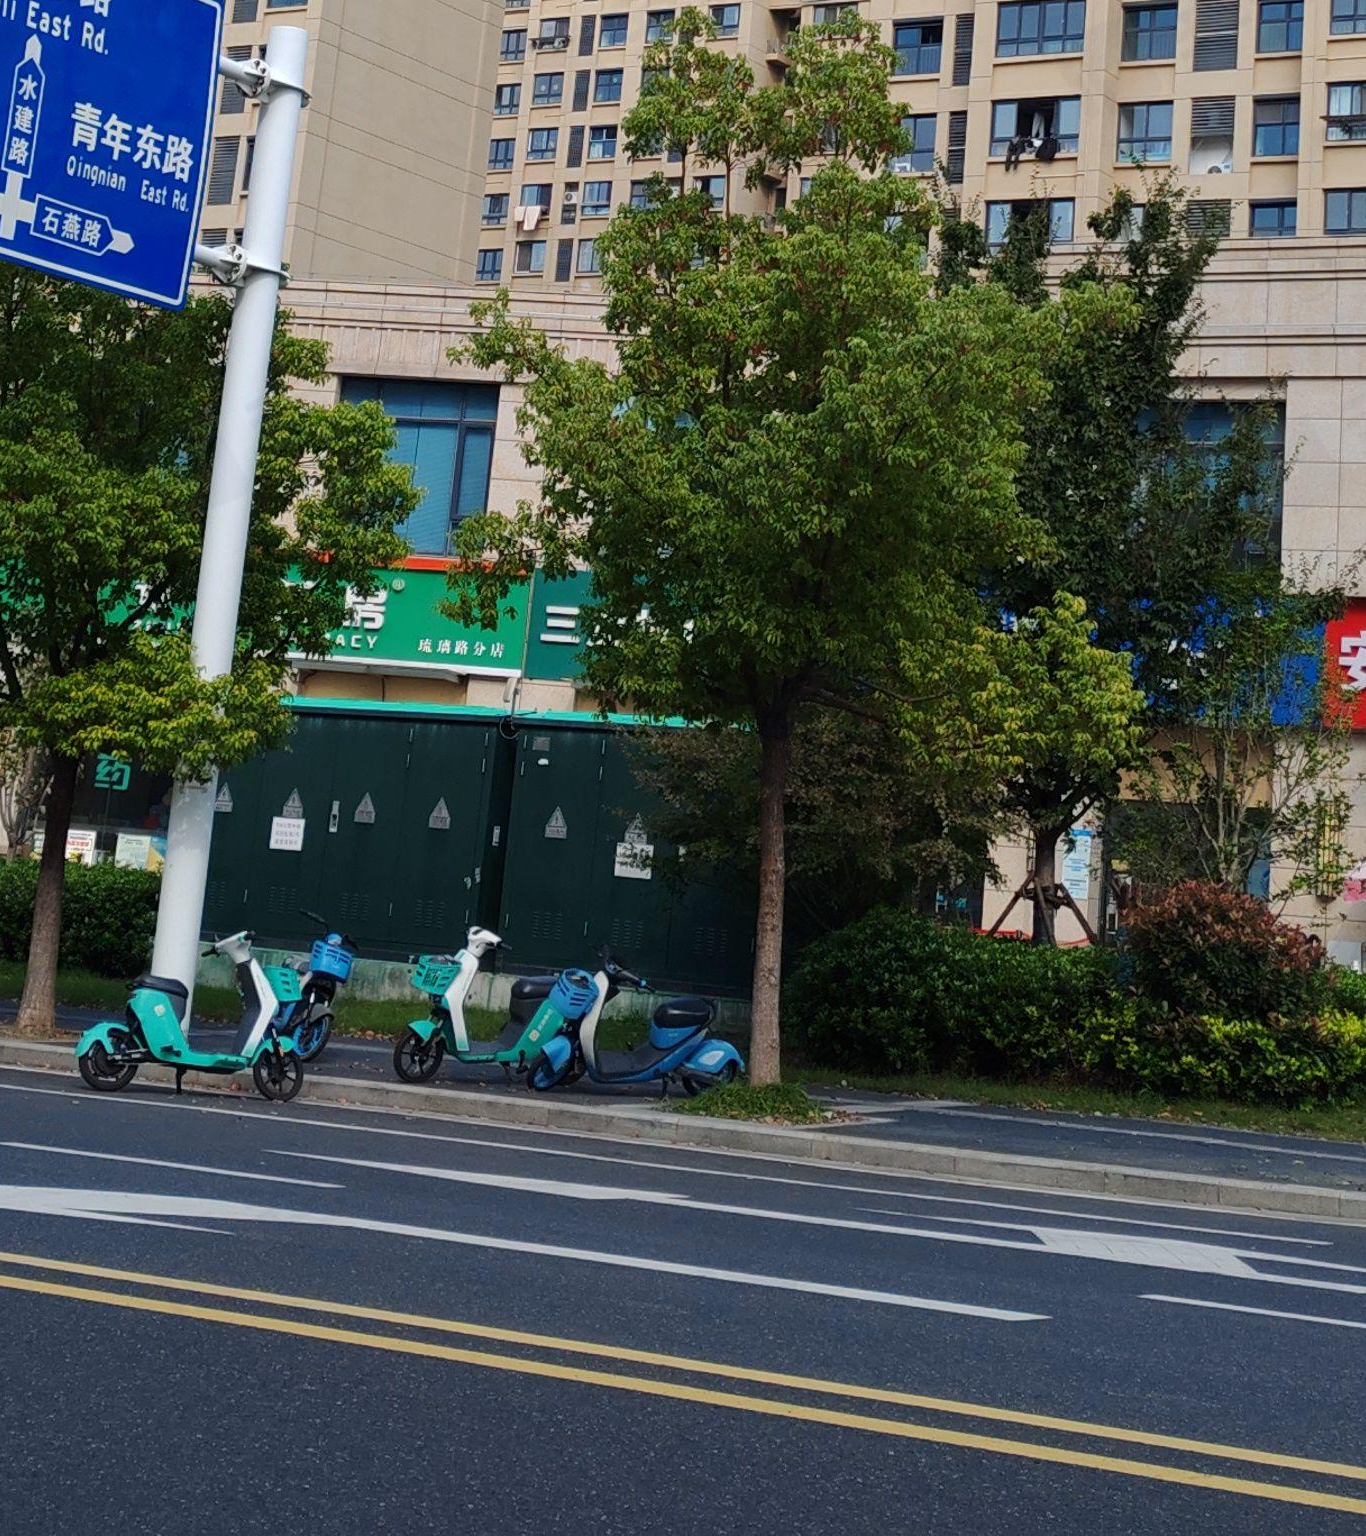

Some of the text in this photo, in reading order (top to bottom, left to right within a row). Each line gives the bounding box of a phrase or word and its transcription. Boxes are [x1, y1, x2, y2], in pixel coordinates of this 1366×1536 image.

[26, 2, 72, 40] East
[82, 21, 110, 56] Rd.
[8, 75, 39, 167] 水建路
[71, 102, 194, 183] 青年东路
[66, 154, 190, 213] Qingnian East Rd.
[41, 207, 102, 247] 石燕路
[417, 638, 505, 659] 琉璃路分店
